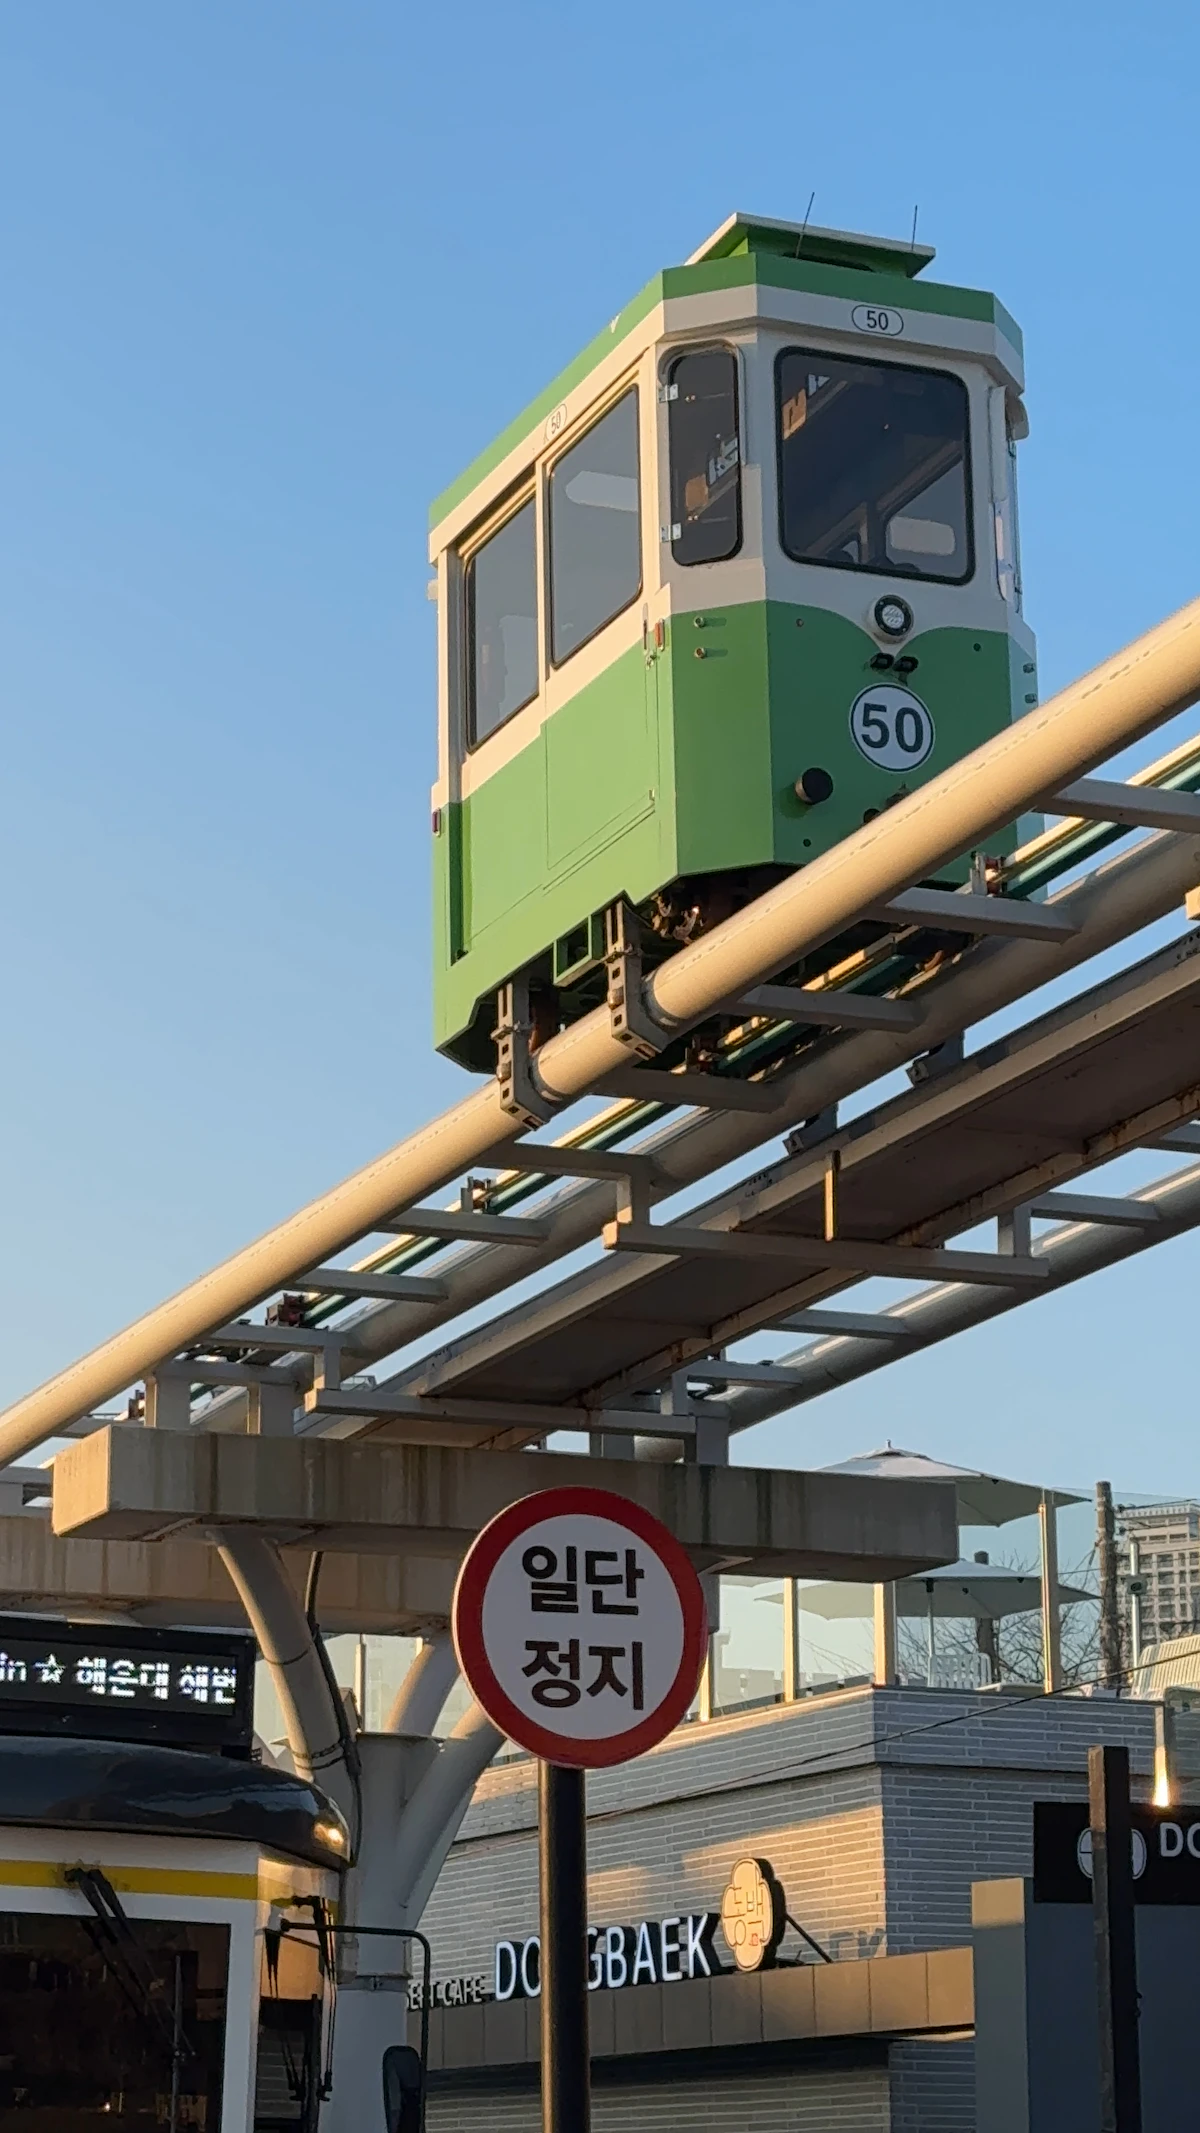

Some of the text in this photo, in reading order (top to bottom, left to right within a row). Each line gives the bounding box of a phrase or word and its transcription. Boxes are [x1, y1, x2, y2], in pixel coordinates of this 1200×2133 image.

[866, 309, 889, 331] 50
[861, 702, 924, 754] 50
[521, 1545, 645, 1616] 일단
[75, 1656, 170, 1700] 해운대
[179, 1663, 236, 1704] 해변
[521, 1638, 645, 1711] 정지
[443, 1975, 482, 2006] CAFE
[495, 1912, 712, 2001] DOGBAEK
